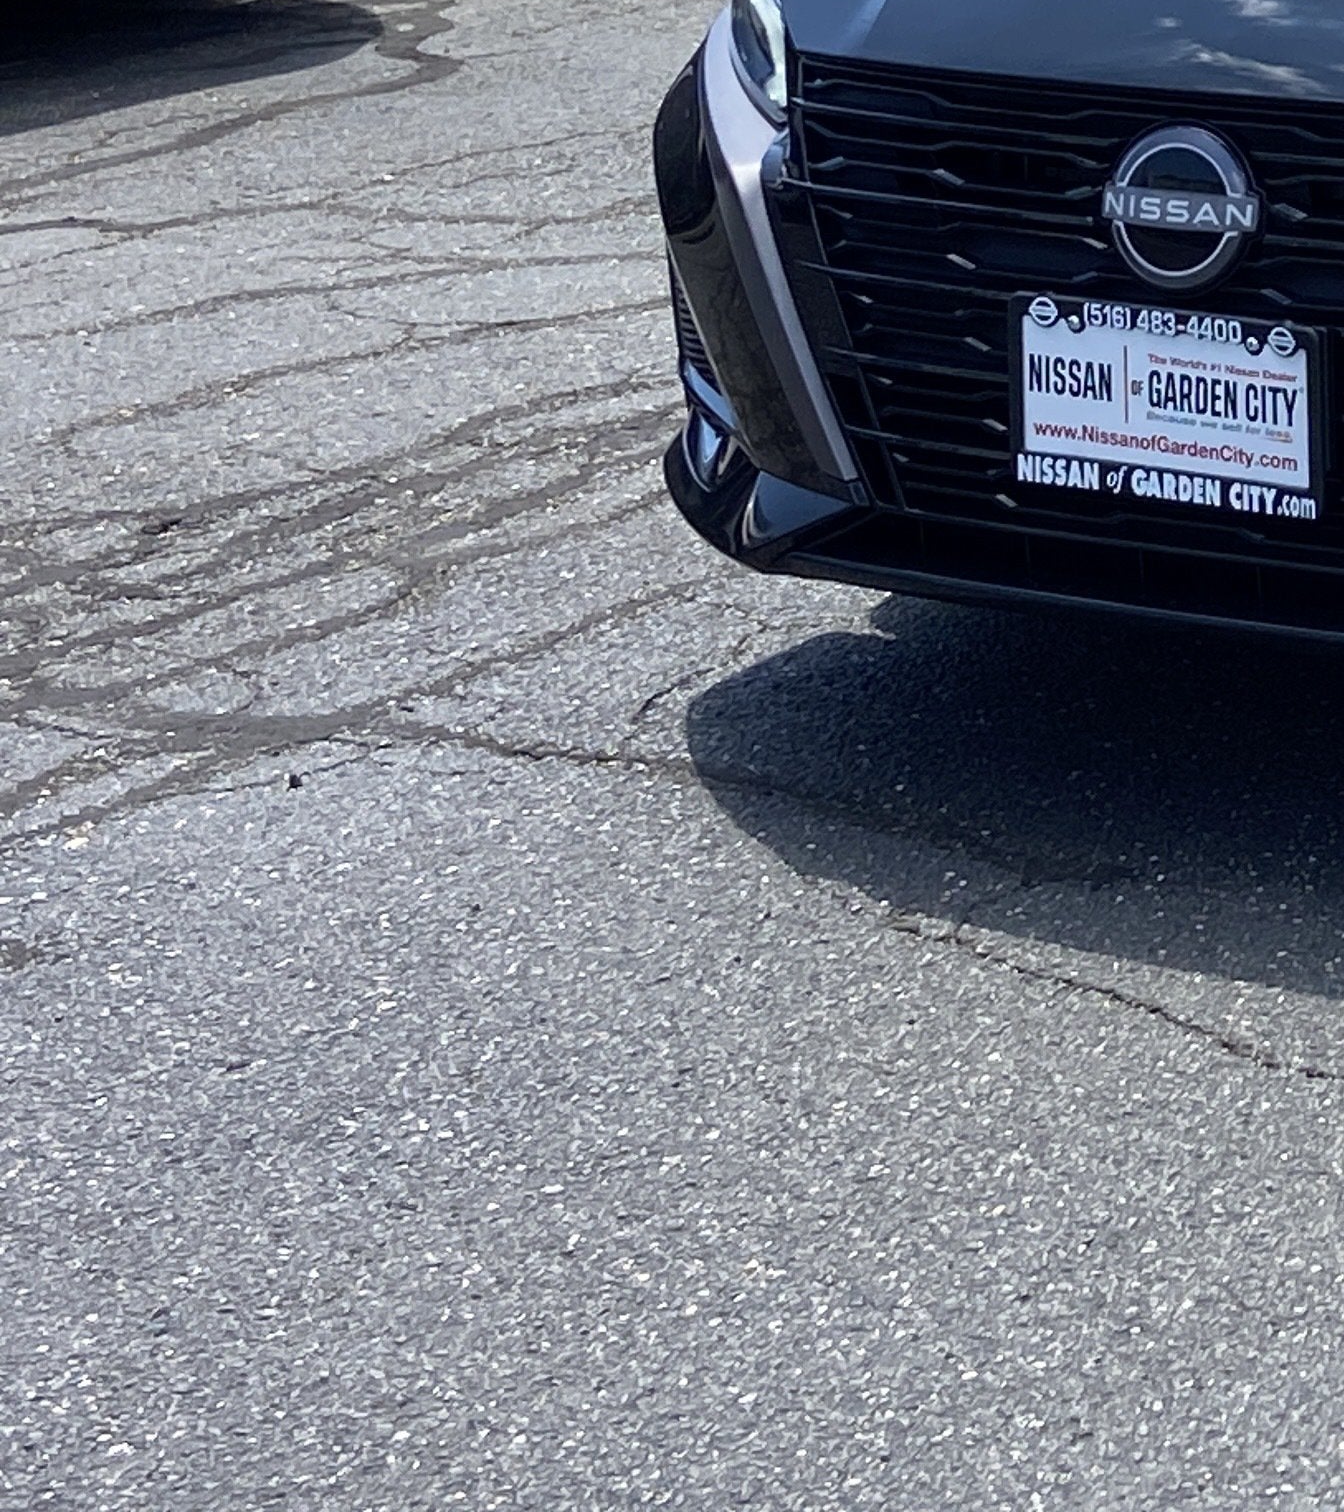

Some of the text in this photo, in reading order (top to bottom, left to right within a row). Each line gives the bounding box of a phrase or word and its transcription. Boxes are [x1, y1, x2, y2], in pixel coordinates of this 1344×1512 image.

[1103, 191, 1255, 228] NISSAN
[1083, 302, 1243, 345] (516) 483-4400
[1028, 353, 1298, 427] NISSAN OF GARDEN CITY
[1033, 421, 1298, 472] www.NissanofGardenCity.com
[1017, 453, 1100, 491] NISSAN
[1106, 465, 1128, 494] of
[1130, 467, 1221, 507] GARDEN
